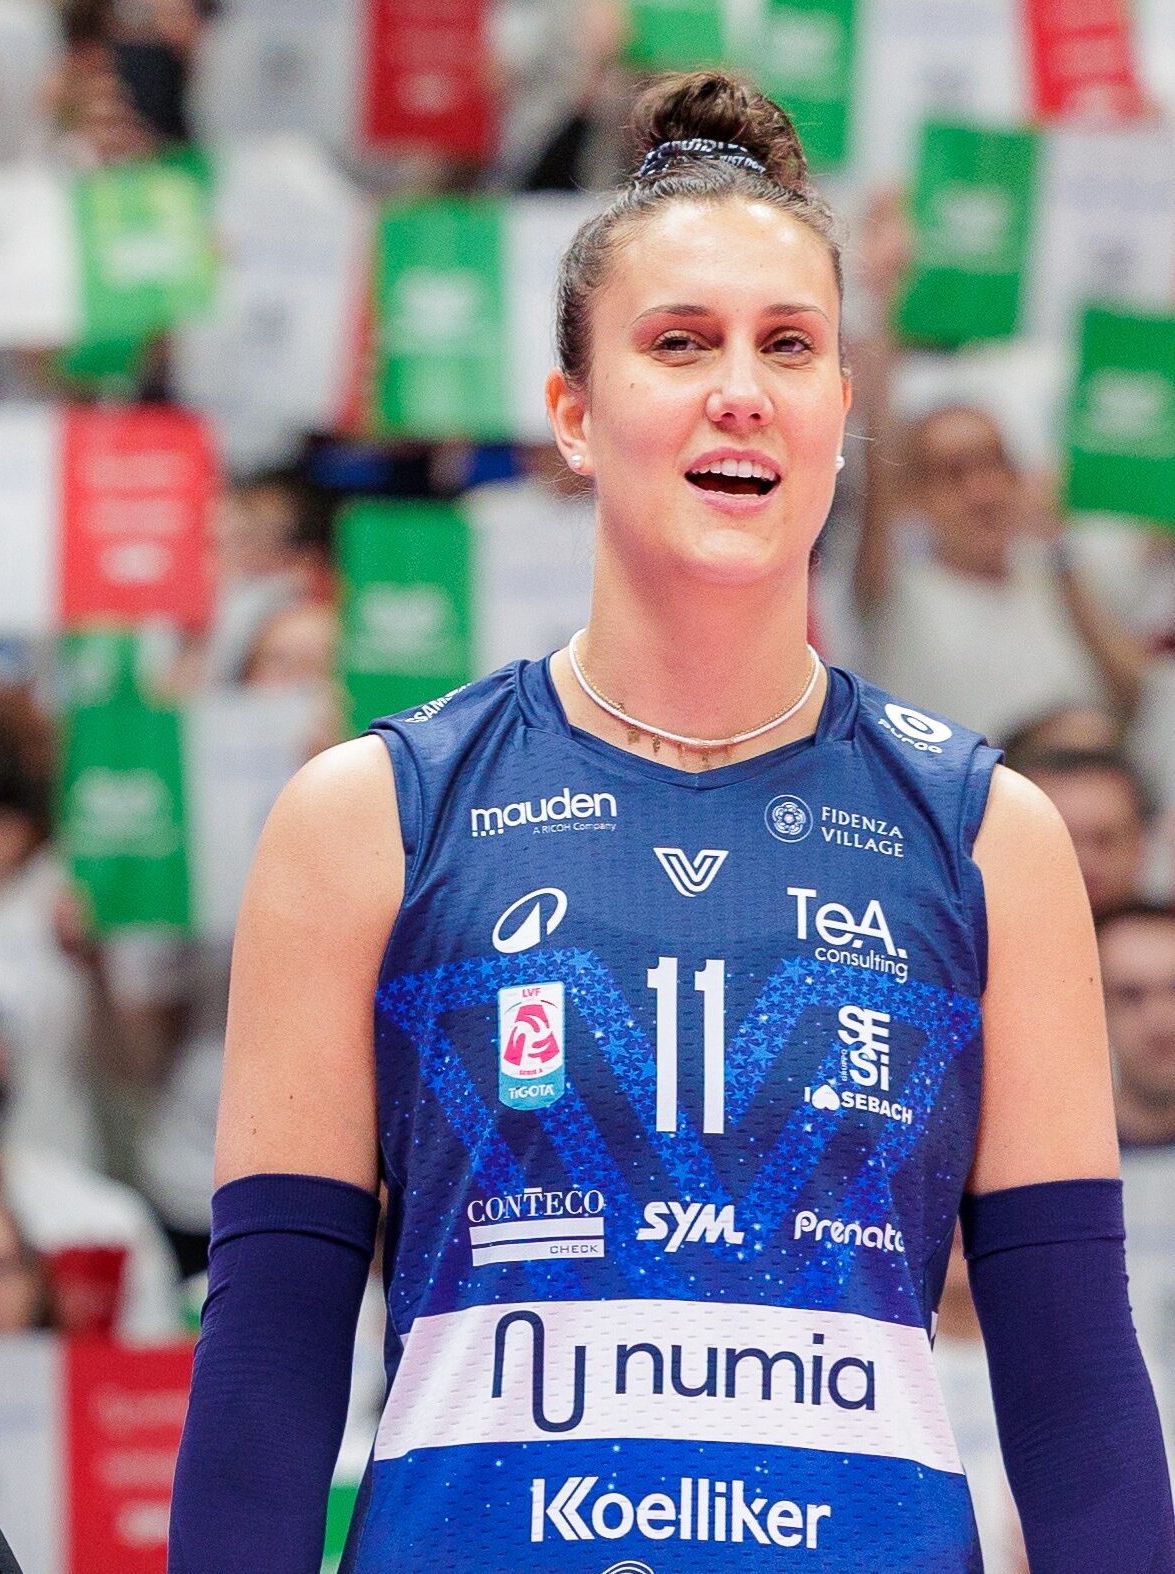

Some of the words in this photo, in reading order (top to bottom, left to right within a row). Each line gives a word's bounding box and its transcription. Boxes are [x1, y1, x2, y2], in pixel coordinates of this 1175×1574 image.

[471, 788, 618, 832] mauden
[821, 806, 904, 839] FIDENZA
[532, 826, 540, 834] A
[542, 823, 572, 834] RICOH
[821, 826, 904, 858] VILLAGE
[815, 947, 908, 983] consulting
[522, 987, 542, 998] LVF
[646, 956, 725, 1134] 11
[841, 1090, 913, 1125] SEBACH
[467, 1186, 605, 1224] CONTECO
[636, 1201, 745, 1253] SYM
[549, 1243, 599, 1255] CHECK
[615, 1332, 876, 1411] numia
[531, 1475, 832, 1550] Koelliker
